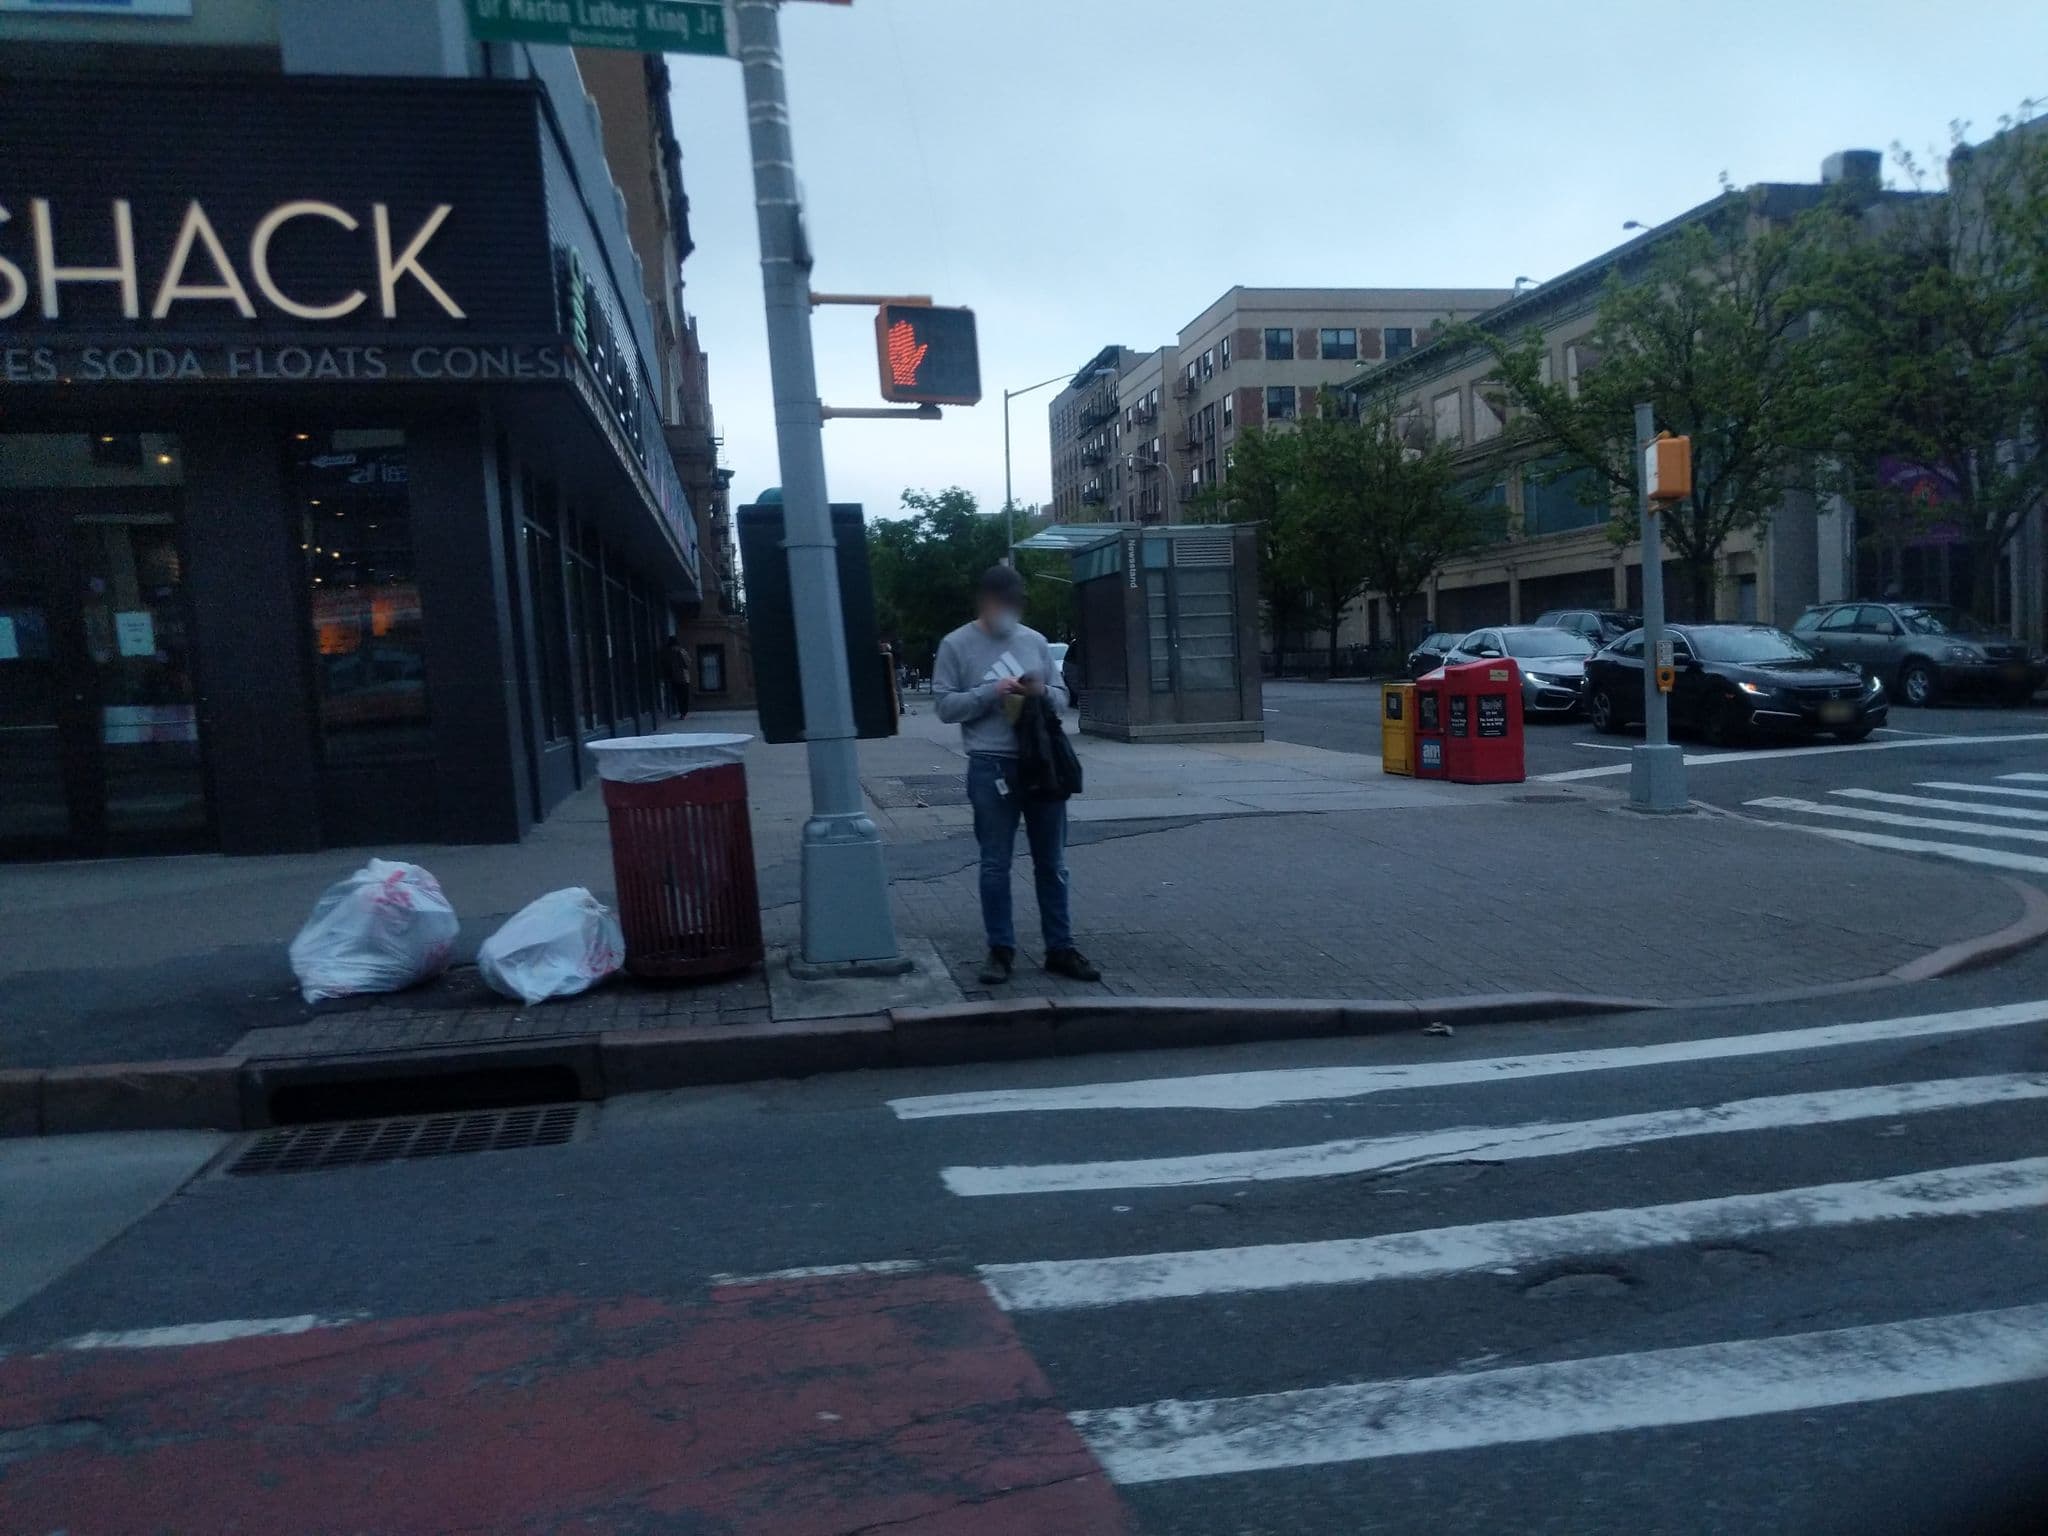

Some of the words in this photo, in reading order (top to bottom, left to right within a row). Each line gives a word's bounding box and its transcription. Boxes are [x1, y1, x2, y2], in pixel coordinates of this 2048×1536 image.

[509, 0, 571, 24] Martin
[577, 0, 638, 28] Luther
[645, 4, 690, 41] King
[698, 9, 718, 36] Jr
[5, 347, 58, 381] ES
[80, 346, 203, 381] SODA
[228, 346, 388, 380] FLOATS
[410, 345, 562, 380] CONES
[1128, 539, 1137, 587] Newsstand
